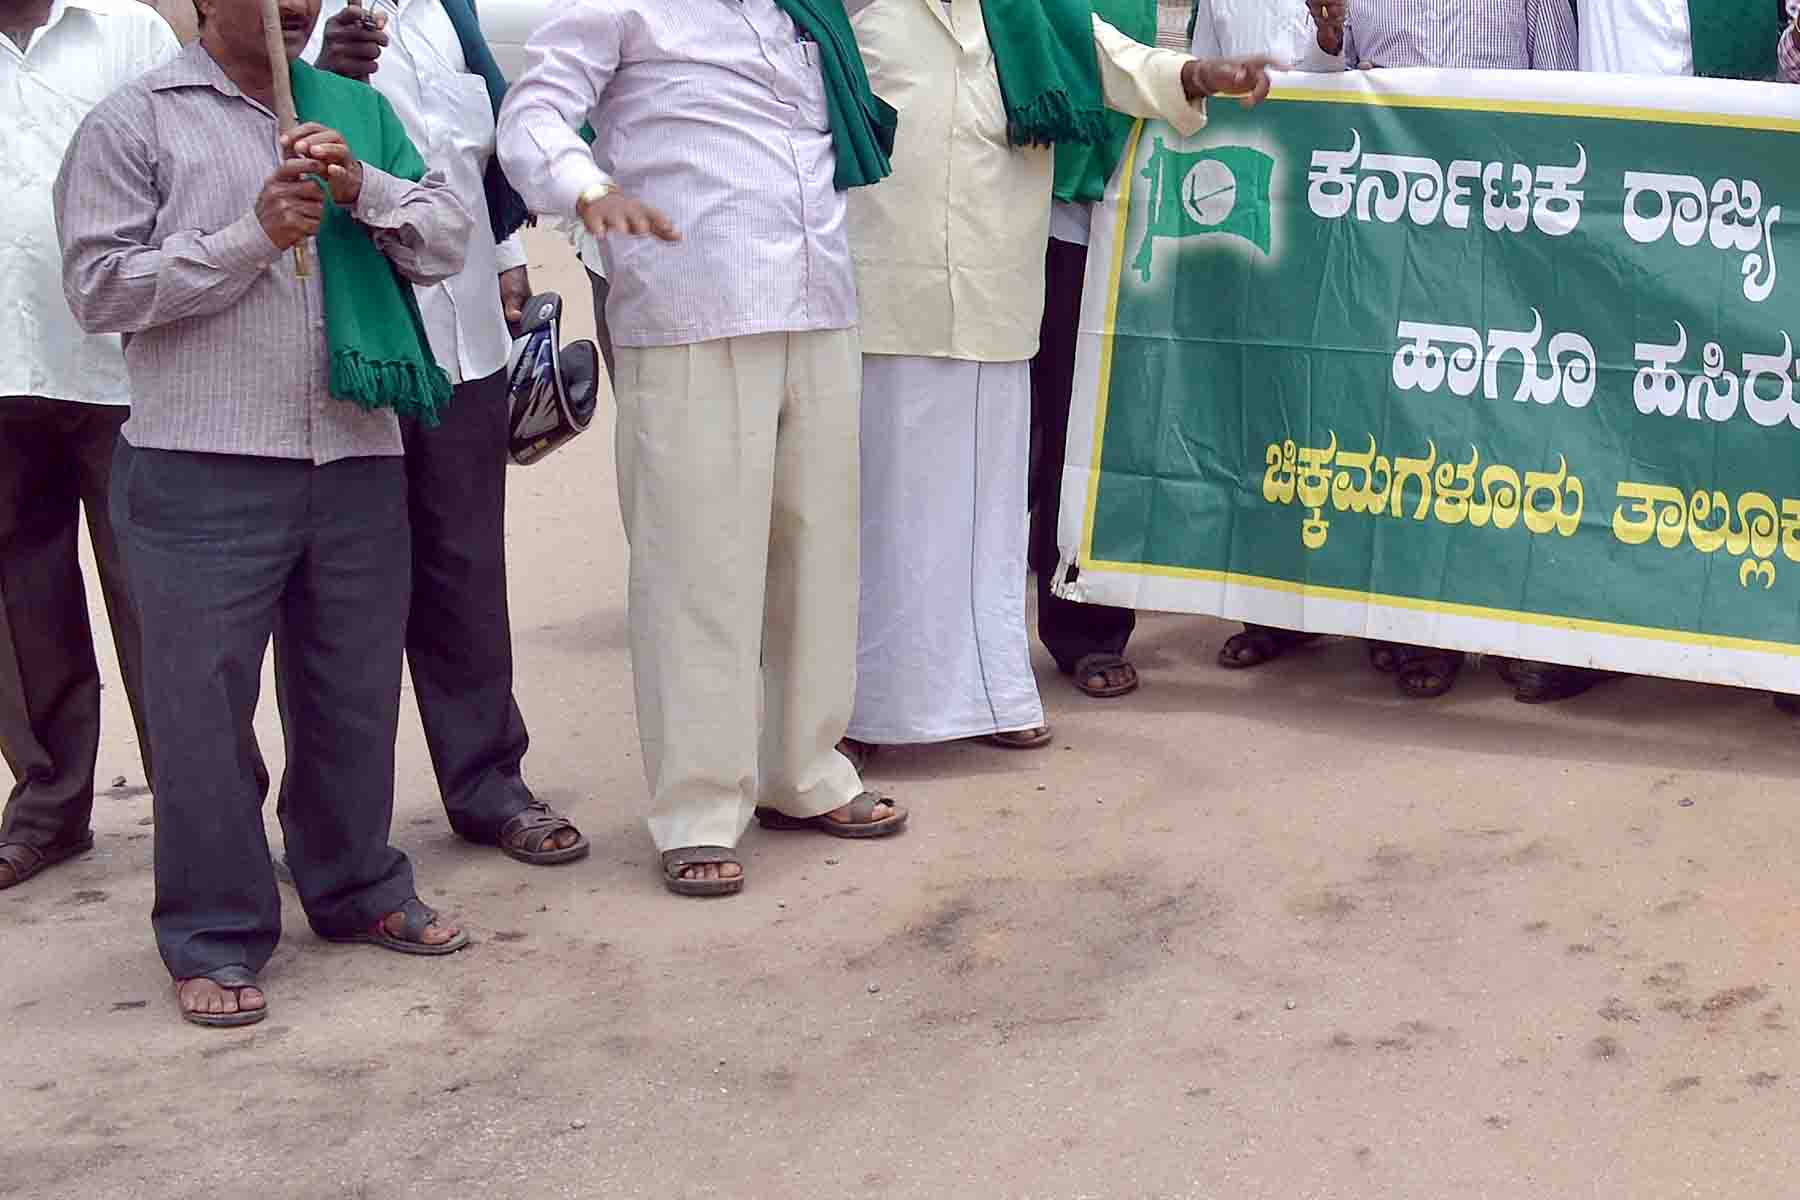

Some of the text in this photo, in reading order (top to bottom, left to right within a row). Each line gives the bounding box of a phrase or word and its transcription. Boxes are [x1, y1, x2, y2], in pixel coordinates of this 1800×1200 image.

[1307, 127, 1587, 236] ಕರ್ನಾಟಕ
[1623, 170, 1781, 302] ರಾಜ್ಯ
[1391, 305, 1597, 408] ಹಾಗೂ
[1262, 428, 1584, 549] ಚಿಕ್ಕಮಗಳೂರು
